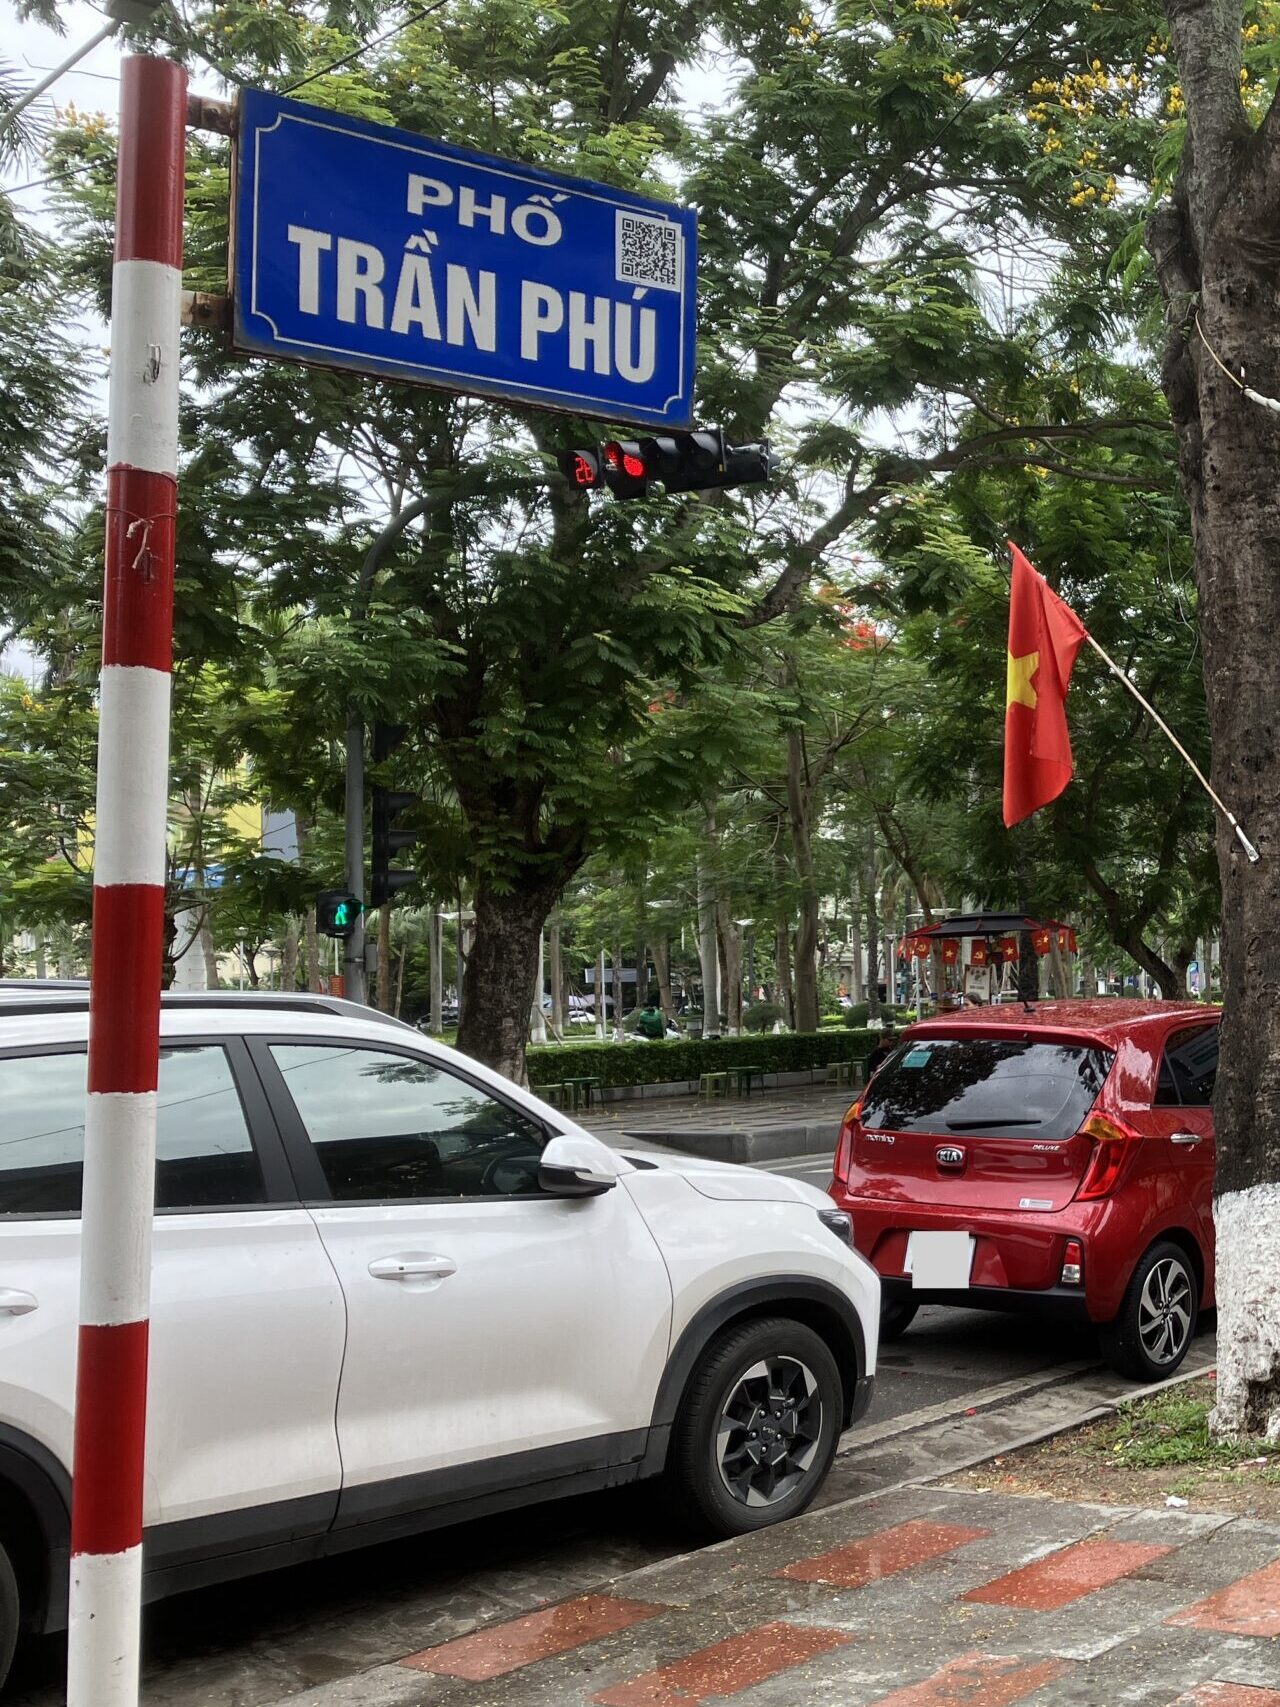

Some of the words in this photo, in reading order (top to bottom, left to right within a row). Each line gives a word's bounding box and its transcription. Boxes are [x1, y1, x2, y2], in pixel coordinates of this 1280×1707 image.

[406, 171, 570, 248] PHỐ
[287, 225, 496, 353] TRẦN
[520, 280, 657, 384] PHÚ
[864, 1133, 896, 1146] morning
[939, 1150, 958, 1161] KIA
